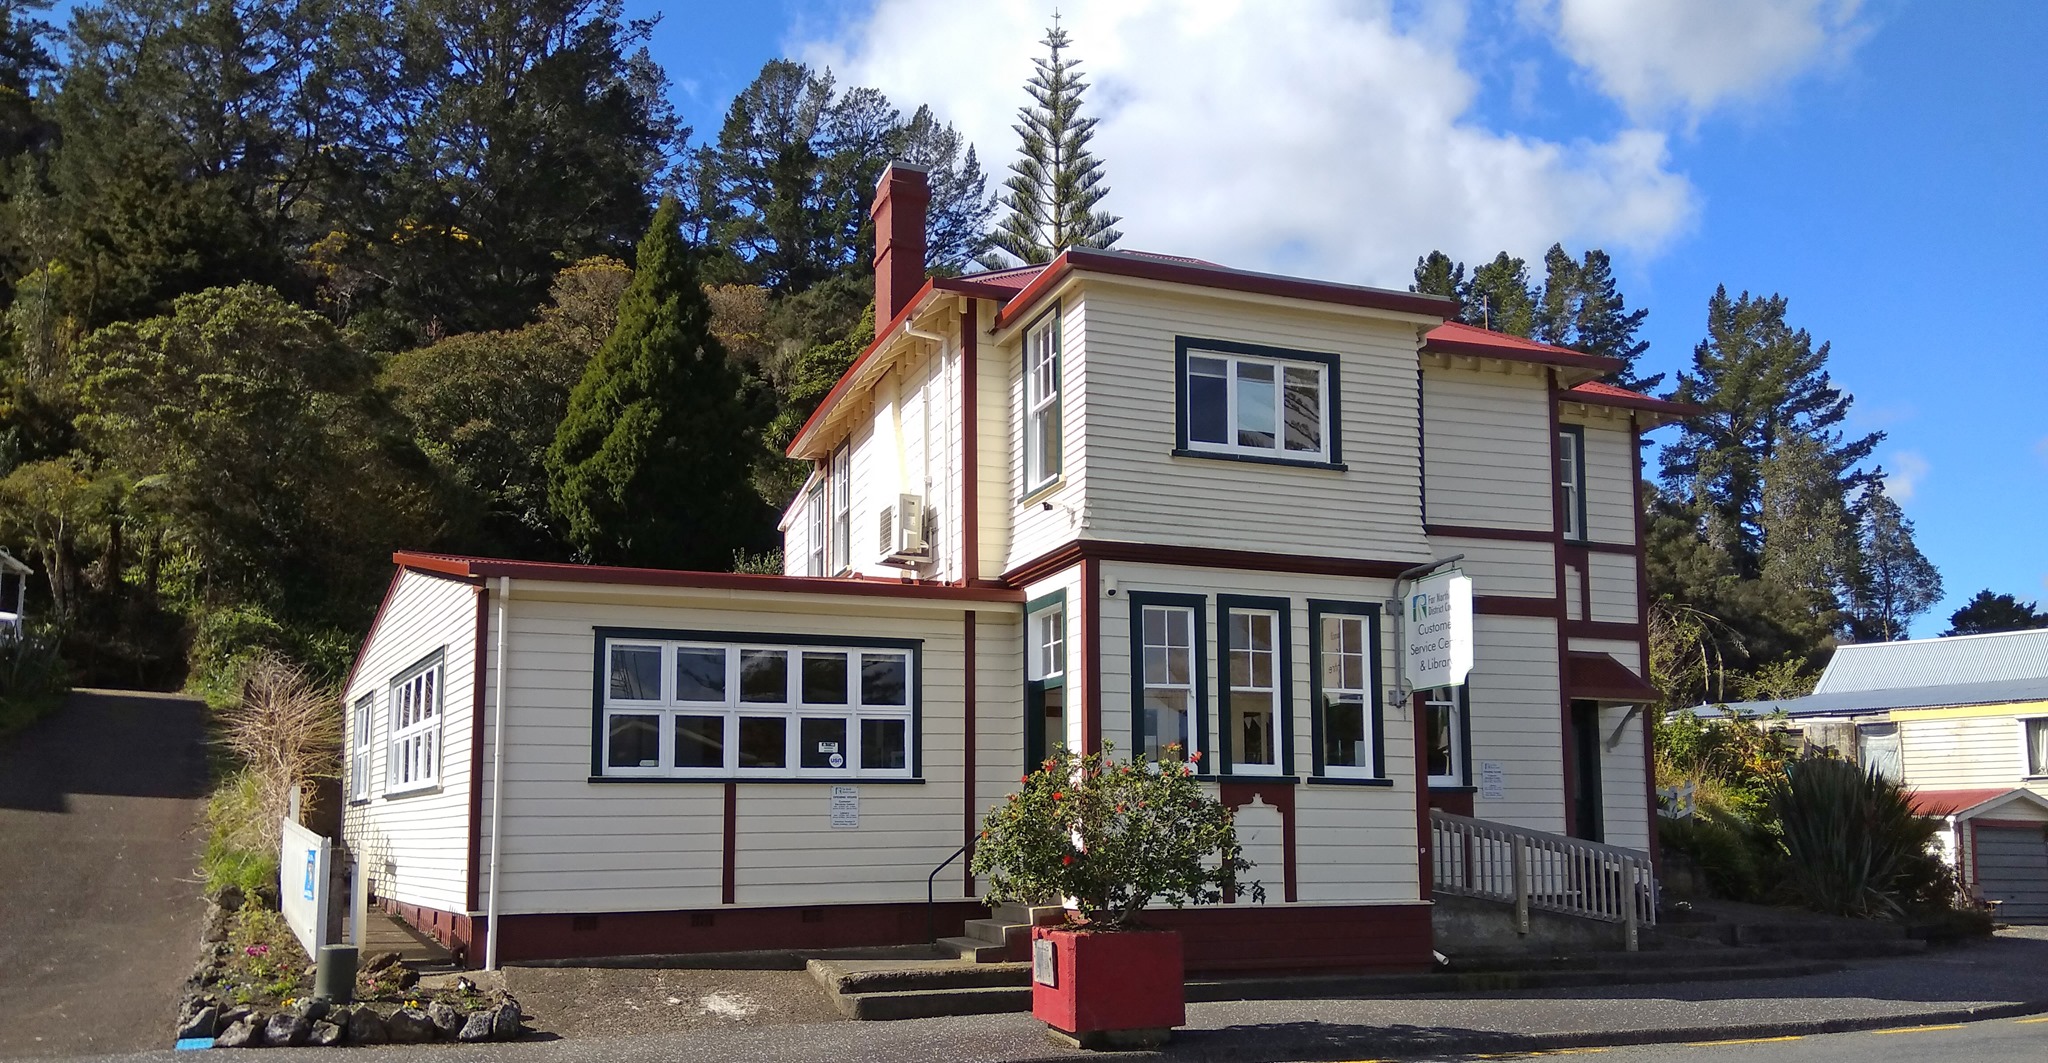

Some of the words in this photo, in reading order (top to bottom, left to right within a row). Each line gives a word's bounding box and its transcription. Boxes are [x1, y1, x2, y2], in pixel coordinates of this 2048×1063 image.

[1418, 621, 1452, 635] Custome
[1410, 641, 1437, 655] Service
[1420, 660, 1426, 671] &
[1427, 657, 1452, 670] Librar
